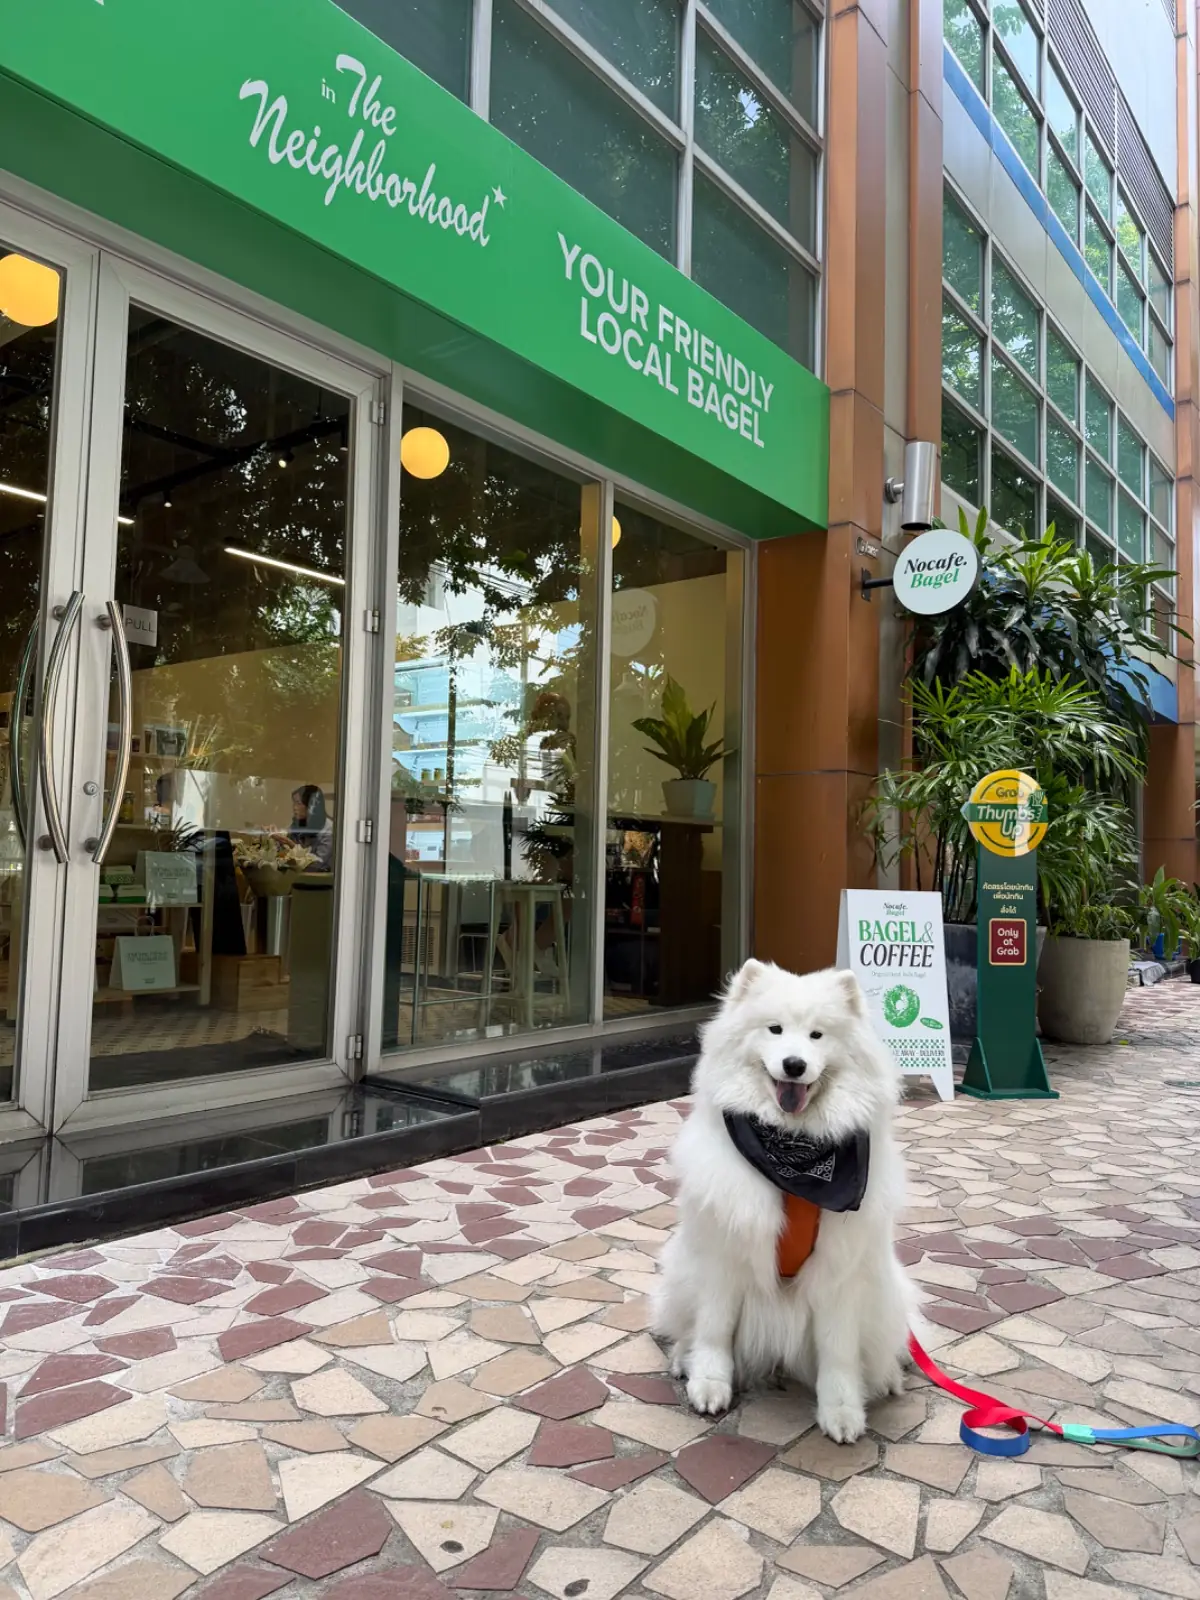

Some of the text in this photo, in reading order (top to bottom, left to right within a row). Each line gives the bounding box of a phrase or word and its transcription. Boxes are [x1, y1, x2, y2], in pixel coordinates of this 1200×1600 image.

[320, 54, 397, 136] in The
[239, 78, 490, 247] Neighborhood
[557, 231, 774, 413] YOUR FRIENDLY
[580, 296, 765, 449] LOCAL BAGEL
[904, 552, 968, 575] Nocafe.
[910, 568, 960, 589] Bagel
[125, 617, 155, 633] PULL
[995, 786, 1025, 798] Grab
[977, 804, 1036, 820] Thumbs
[1002, 809, 1024, 841] Up
[997, 928, 1019, 939] Only
[1003, 938, 1014, 946] at
[860, 943, 935, 968] COFFEE
[996, 946, 1020, 956] Grab
